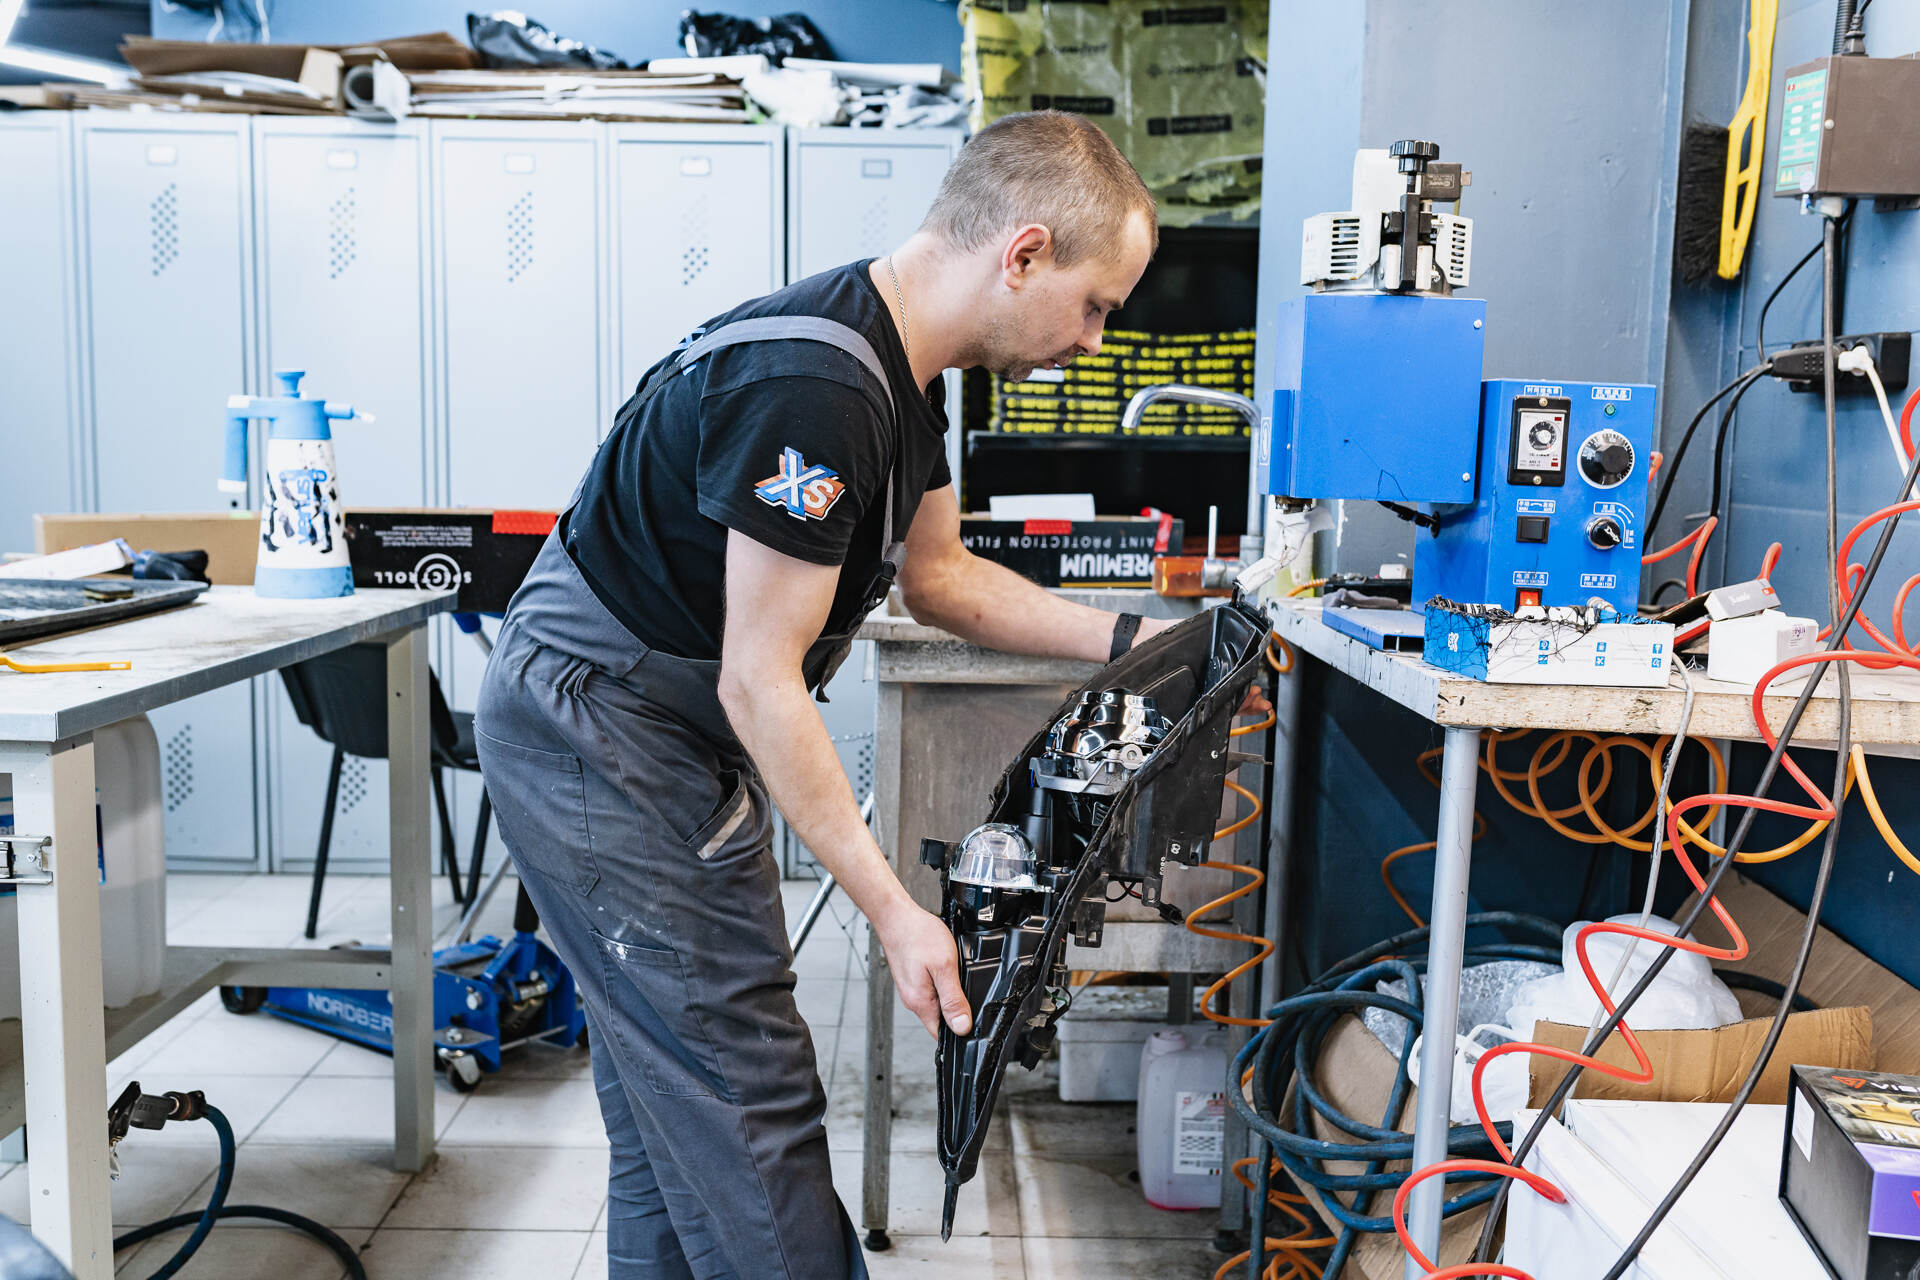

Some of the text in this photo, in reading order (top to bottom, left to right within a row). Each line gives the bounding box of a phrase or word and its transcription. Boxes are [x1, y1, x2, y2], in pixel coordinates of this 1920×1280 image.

[963, 536, 1154, 548] AINT PROTECTION FILM
[307, 991, 394, 1034] NORDBER
